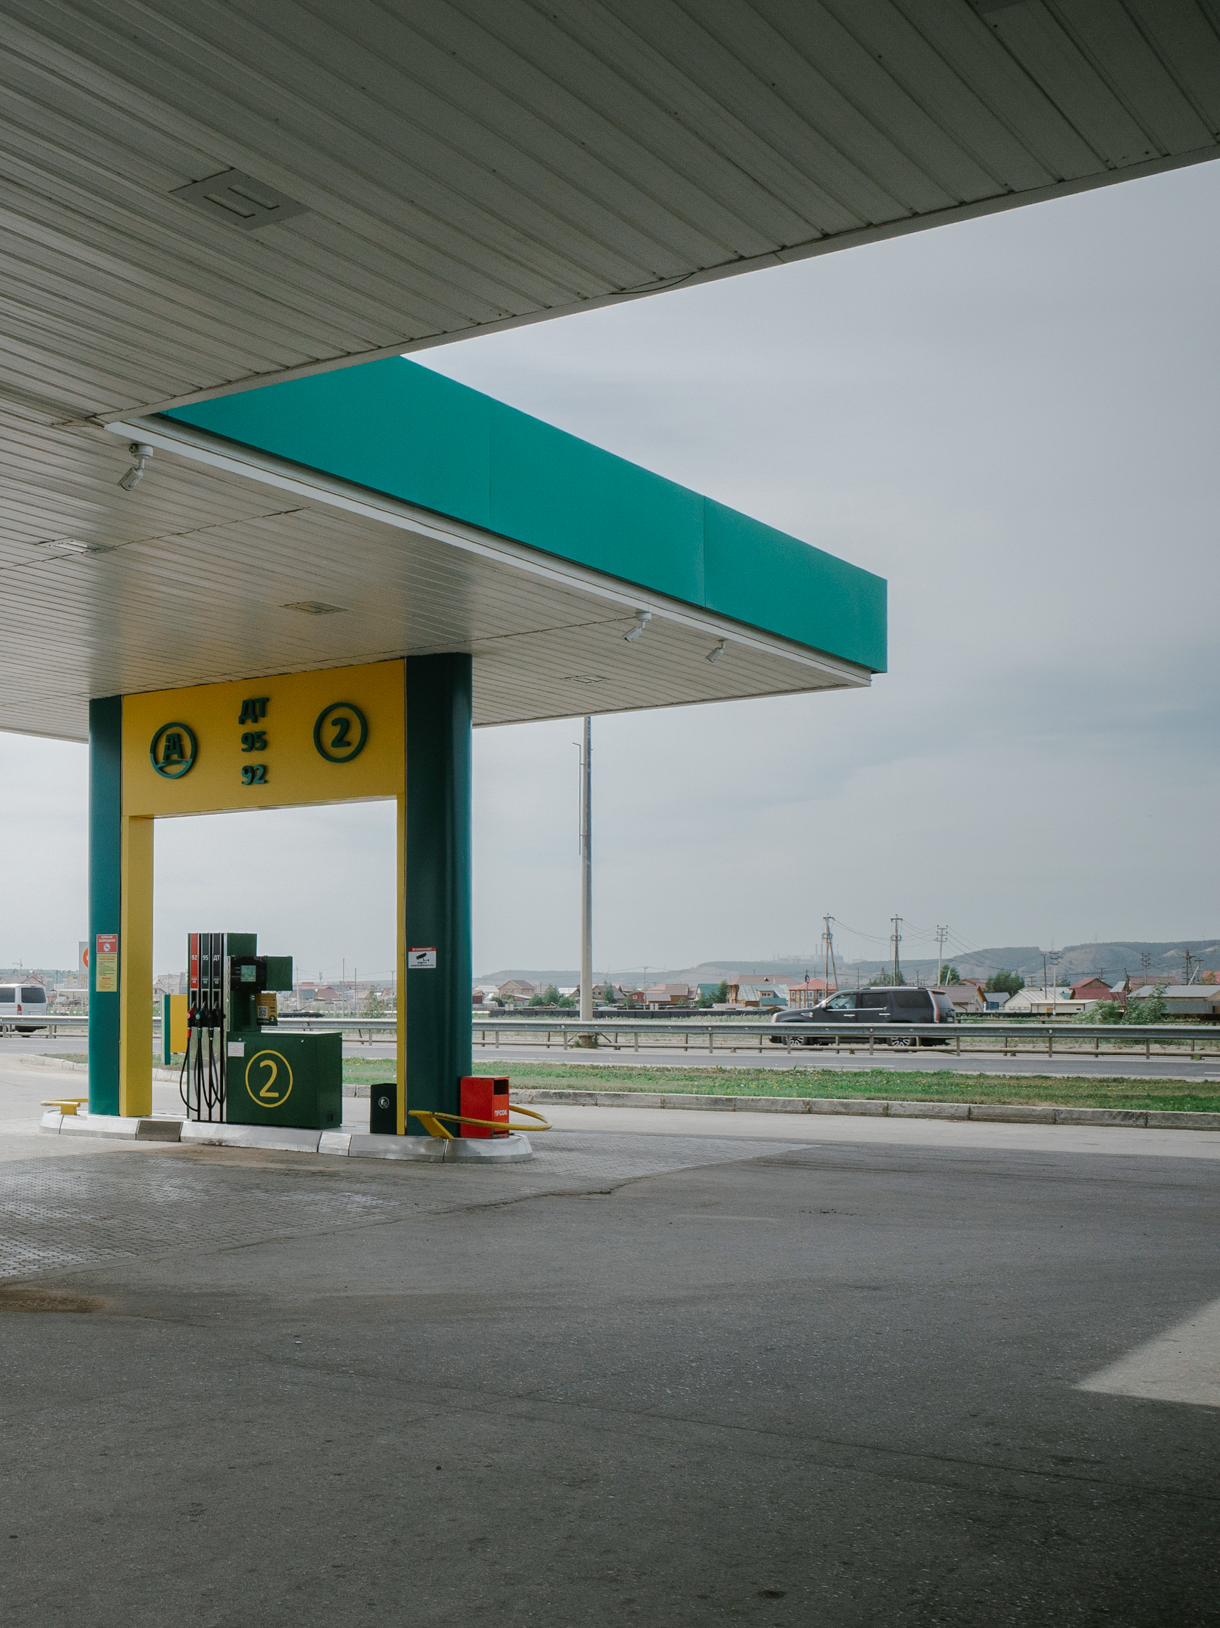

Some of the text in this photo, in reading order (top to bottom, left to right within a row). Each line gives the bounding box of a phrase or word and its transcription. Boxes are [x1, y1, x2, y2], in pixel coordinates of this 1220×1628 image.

[238, 697, 270, 725] ДТ
[241, 731, 267, 752] 95
[331, 717, 351, 748] 2
[241, 764, 267, 785] 92
[213, 954, 220, 962] ДТ
[259, 1059, 279, 1098] 2
